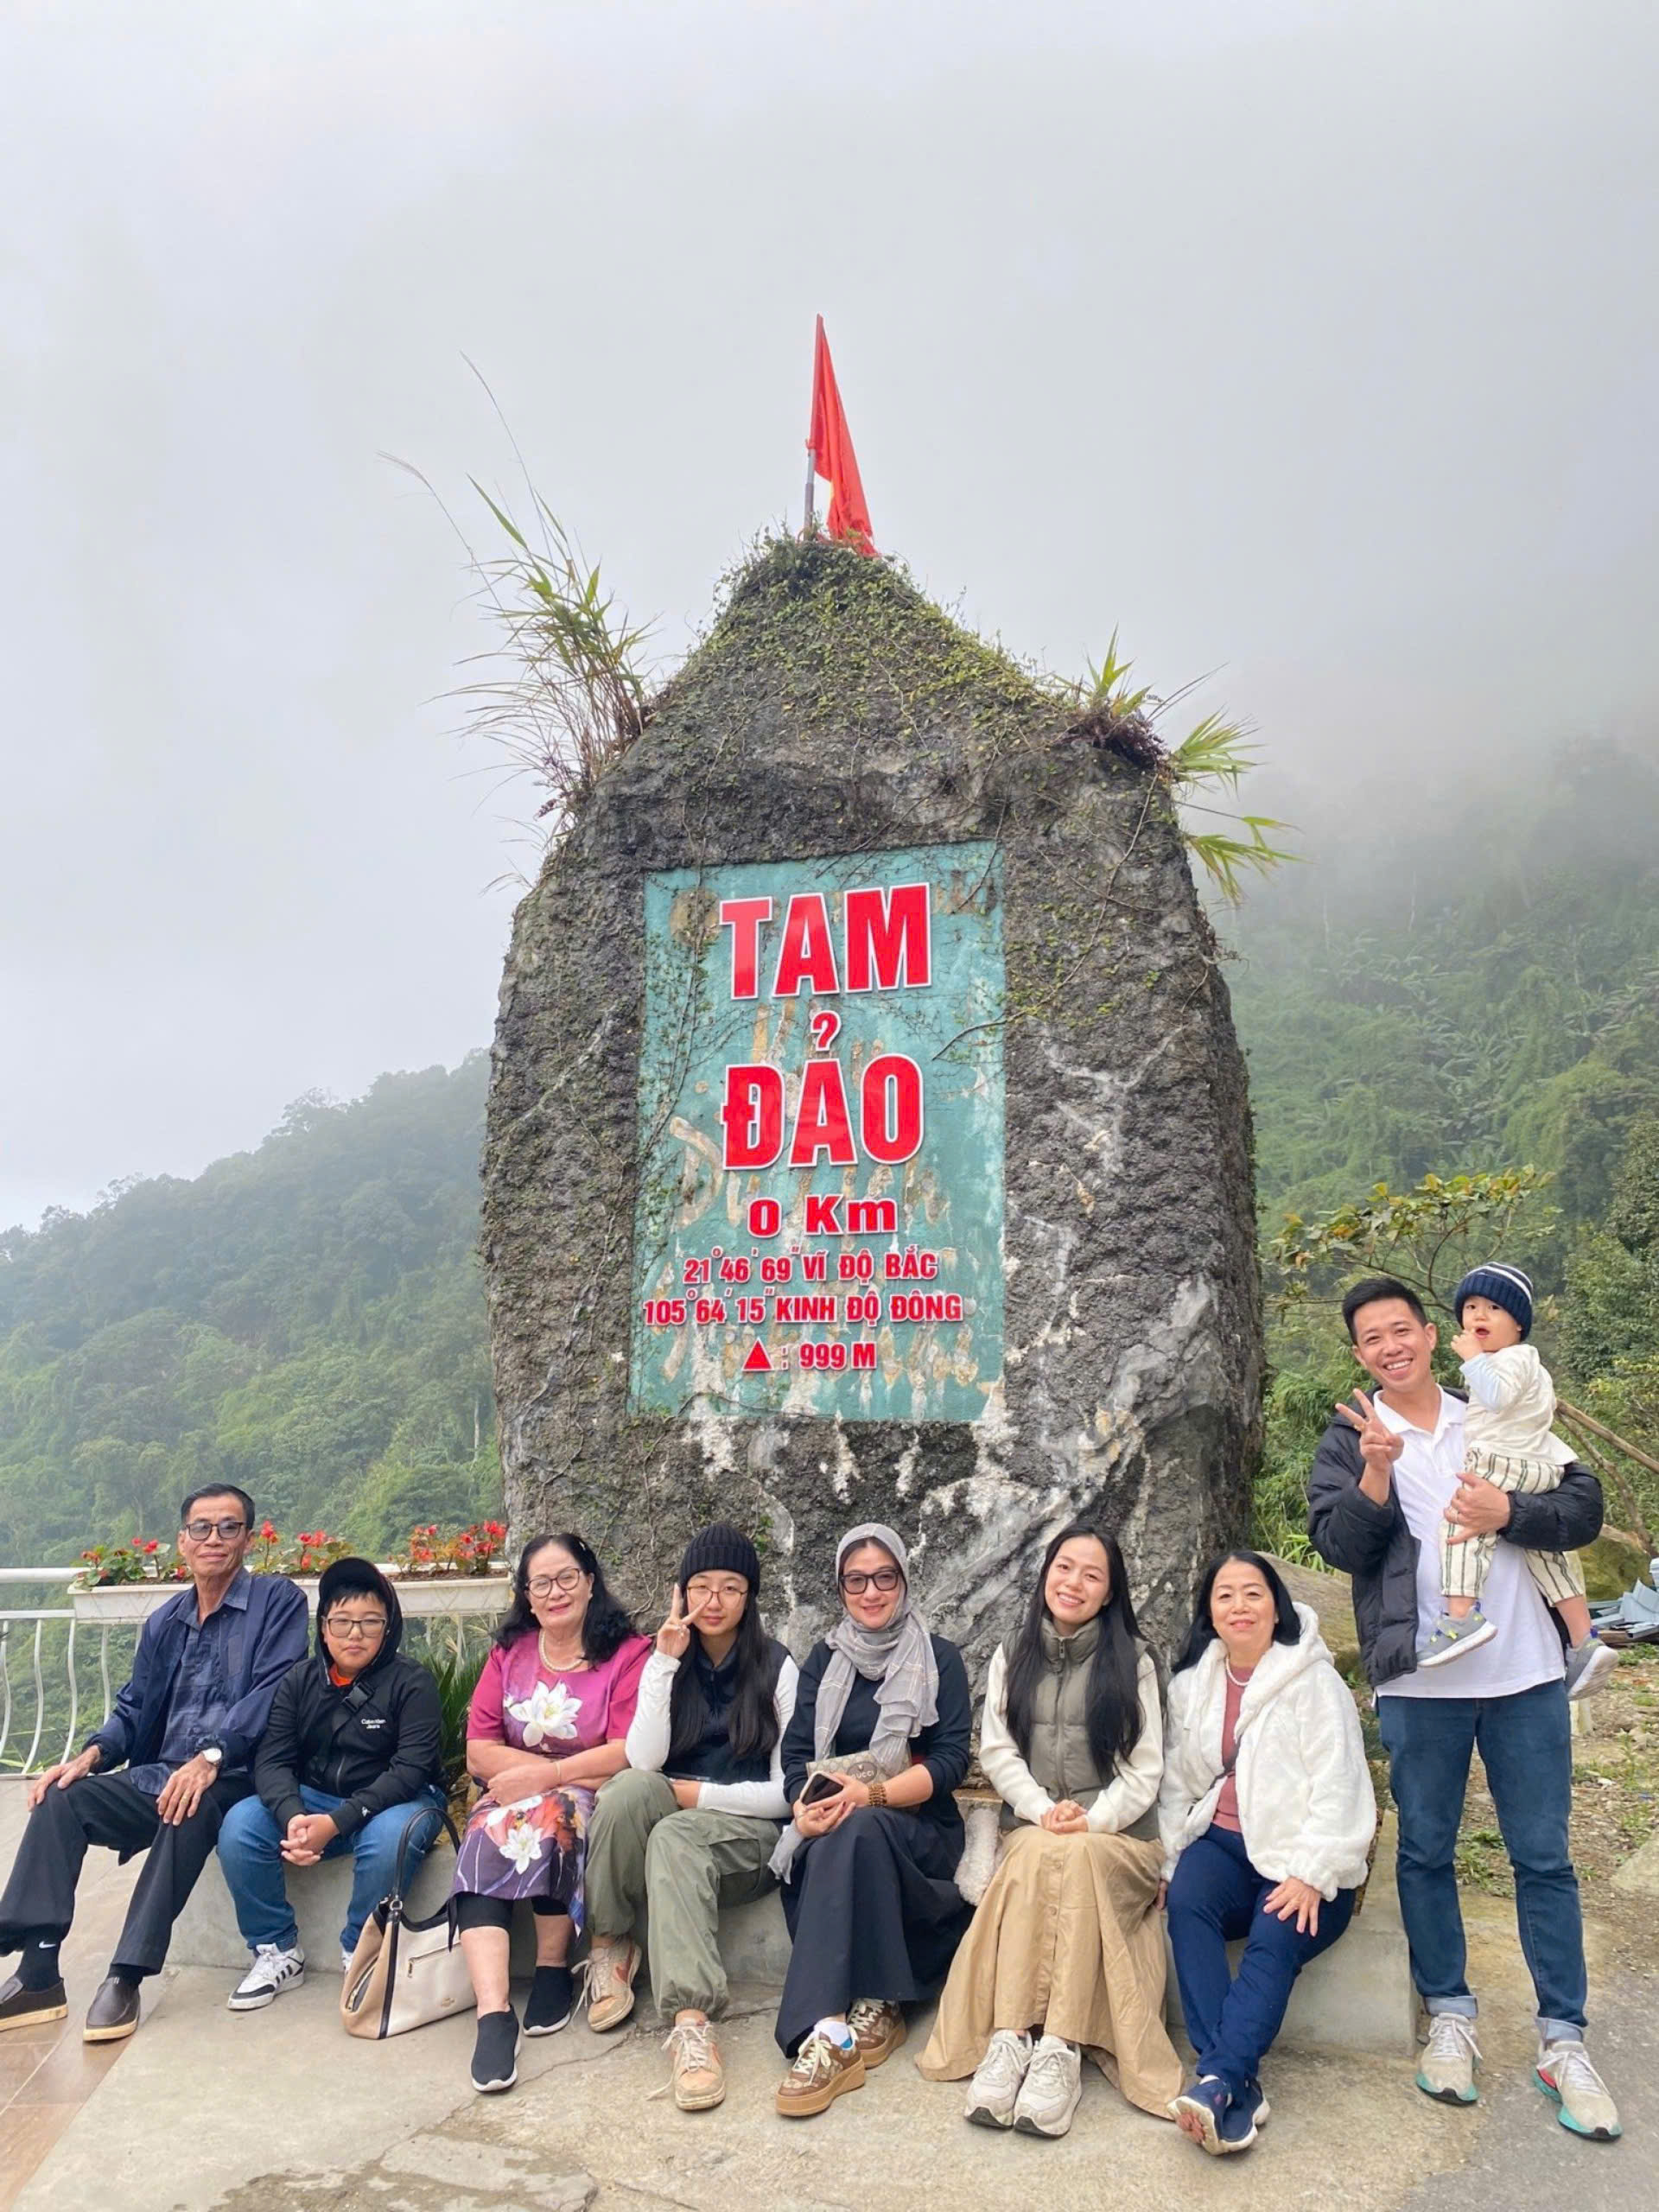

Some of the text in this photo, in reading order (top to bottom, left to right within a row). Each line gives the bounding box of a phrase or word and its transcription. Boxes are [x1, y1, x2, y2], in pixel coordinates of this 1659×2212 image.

[720, 882, 931, 1000] TAM
[720, 1010, 924, 1170] ĐẢO
[804, 1194, 897, 1235] Km
[801, 1249, 829, 1281] VĨ
[838, 1248, 874, 1286] ĐỘ
[884, 1244, 938, 1280] BẮC
[775, 1295, 837, 1323] KINH
[846, 1289, 881, 1327] ĐỘ
[889, 1288, 963, 1322] ĐÔNG
[799, 1342, 847, 1370] 999
[851, 1341, 877, 1370] M
